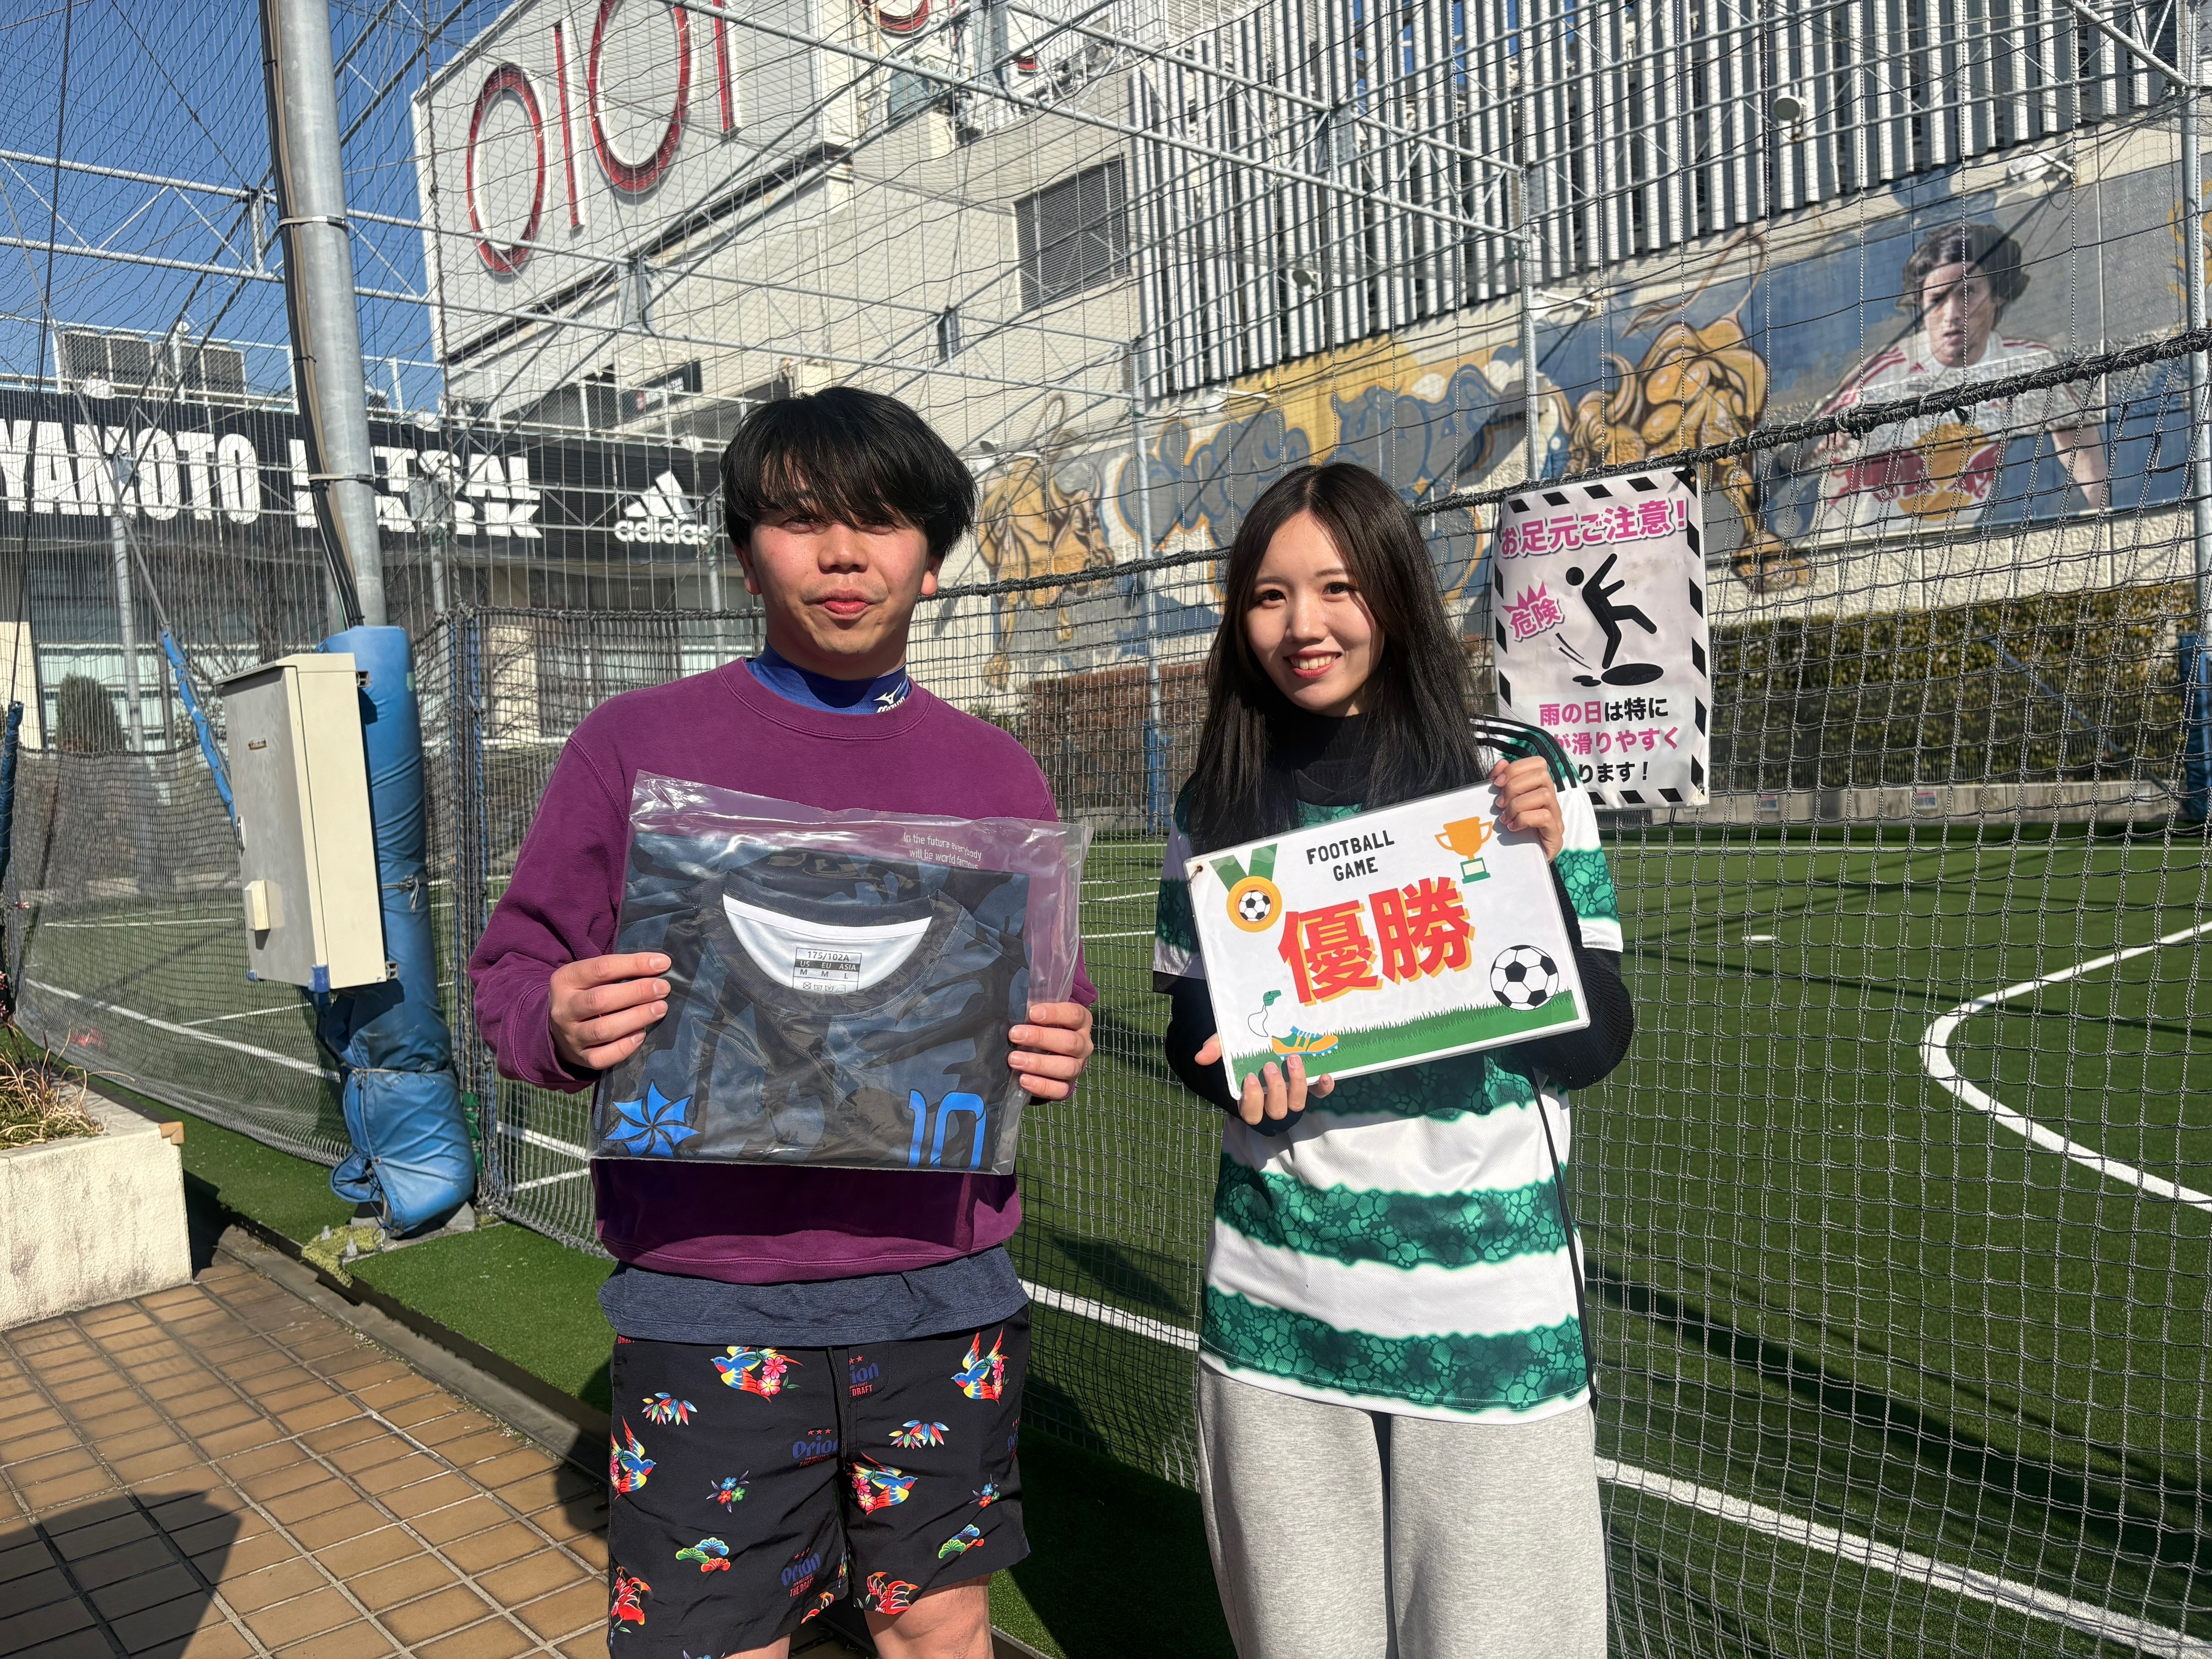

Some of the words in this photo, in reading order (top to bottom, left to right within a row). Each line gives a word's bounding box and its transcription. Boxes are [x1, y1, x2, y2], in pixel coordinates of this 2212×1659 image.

[614, 516, 711, 545] adidas
[1501, 500, 1688, 556] お足元ご注意！
[1510, 598, 1561, 638] 危険
[1539, 697, 1668, 726] 雨の日は特に
[1554, 726, 1678, 755] が滑りやすく
[1578, 761, 1648, 784] ります！
[903, 832, 911, 842] In
[913, 834, 925, 844] the
[927, 836, 950, 848] future
[952, 842, 982, 861] everybody
[909, 848, 922, 859] will
[925, 849, 933, 860] be
[935, 854, 955, 865] world
[1306, 830, 1395, 865] FOOTBALL
[1333, 857, 1379, 881] GAME
[807, 951, 849, 961] 175/102A
[1278, 876, 1476, 1007] 優勝
[907, 1090, 987, 1171] 10
[850, 1363, 879, 1384] ion
[852, 1385, 873, 1397] DRAFT
